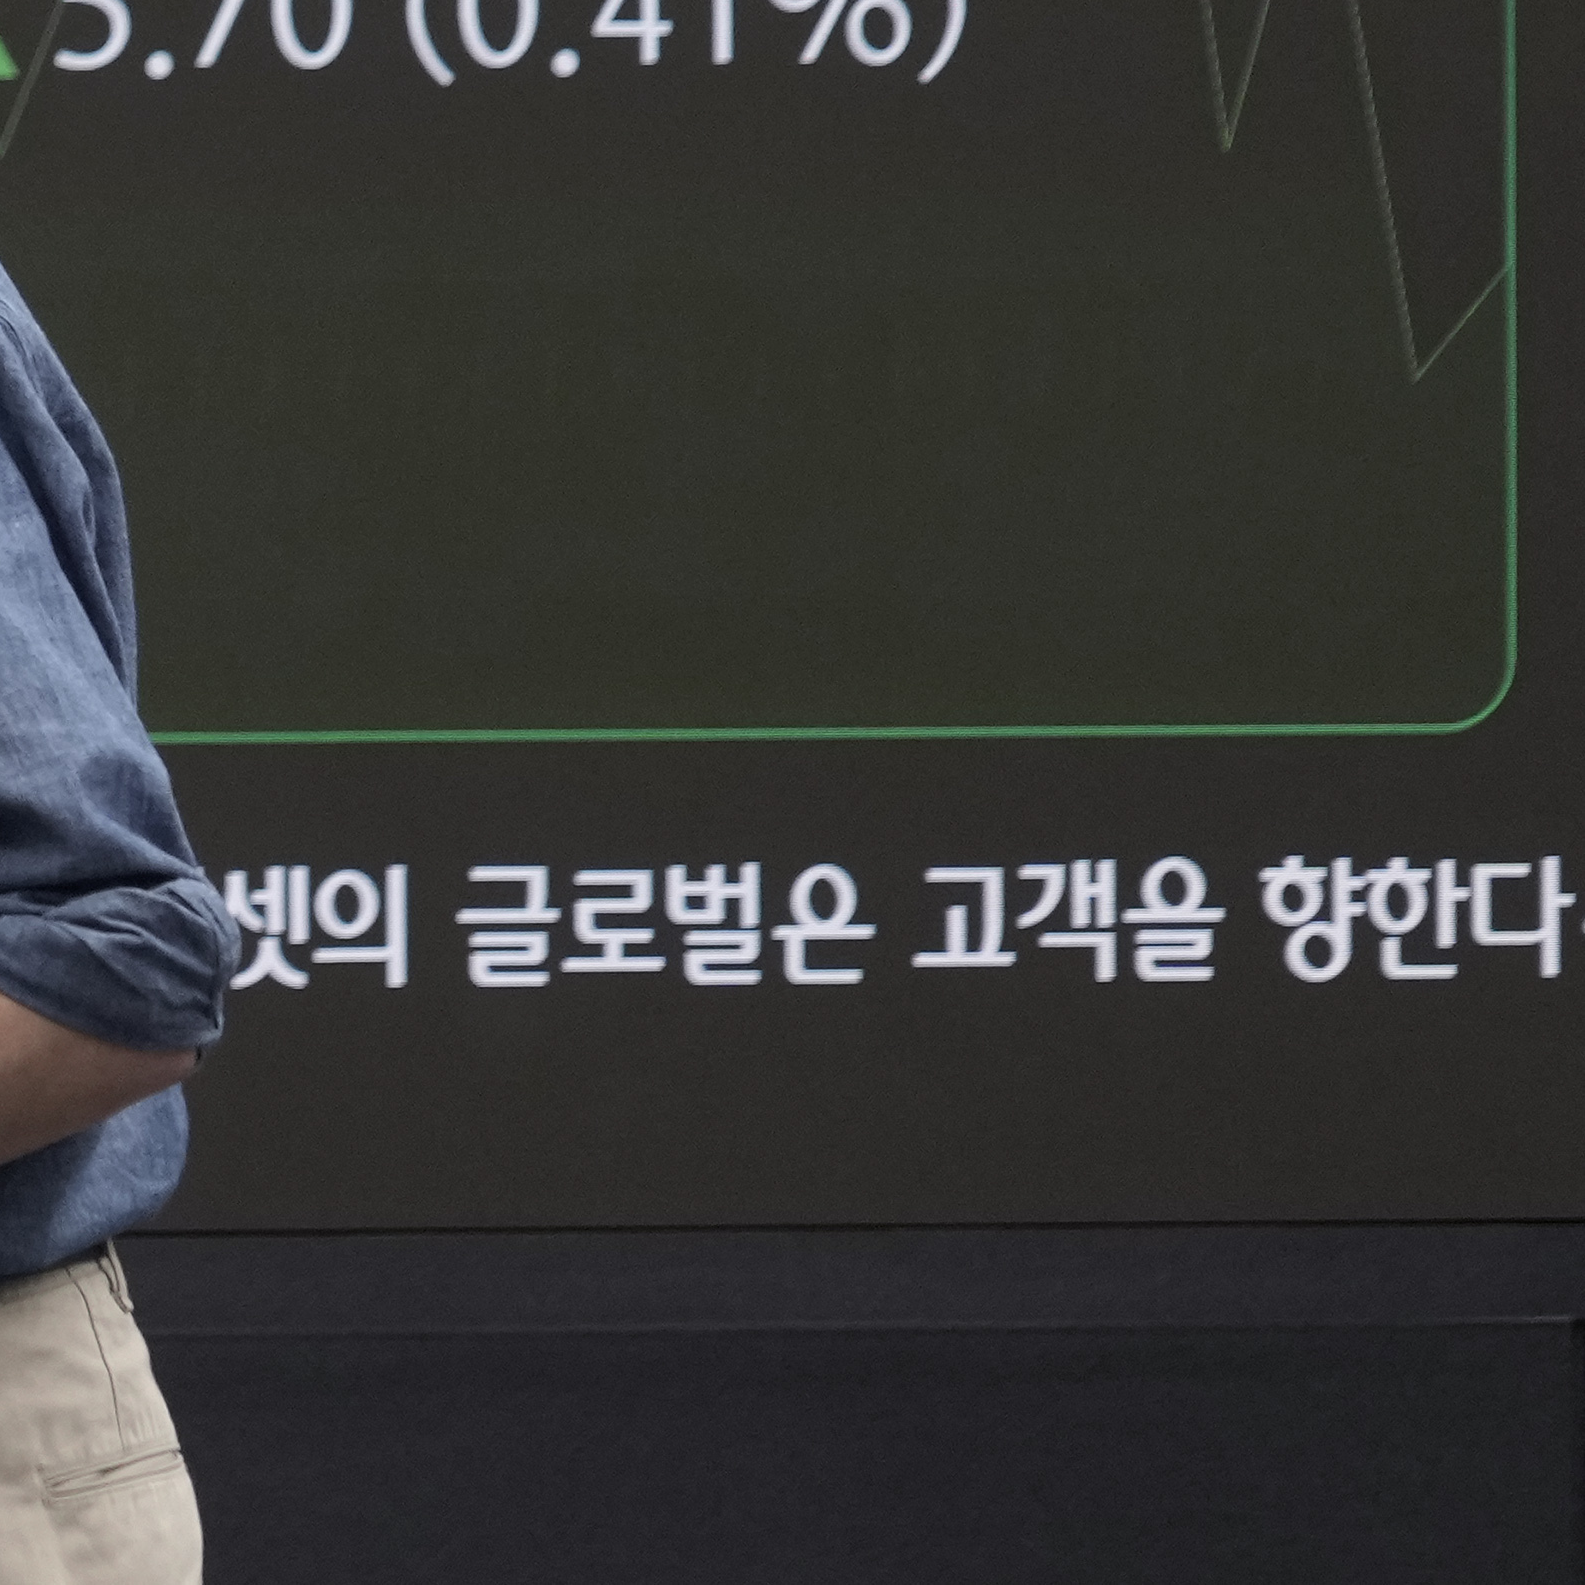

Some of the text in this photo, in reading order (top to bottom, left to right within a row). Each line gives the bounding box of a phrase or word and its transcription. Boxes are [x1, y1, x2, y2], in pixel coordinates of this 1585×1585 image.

[454, 861, 877, 990] 글로벌은
[911, 855, 1228, 984] 고객을
[1257, 854, 1577, 984] 향한다
